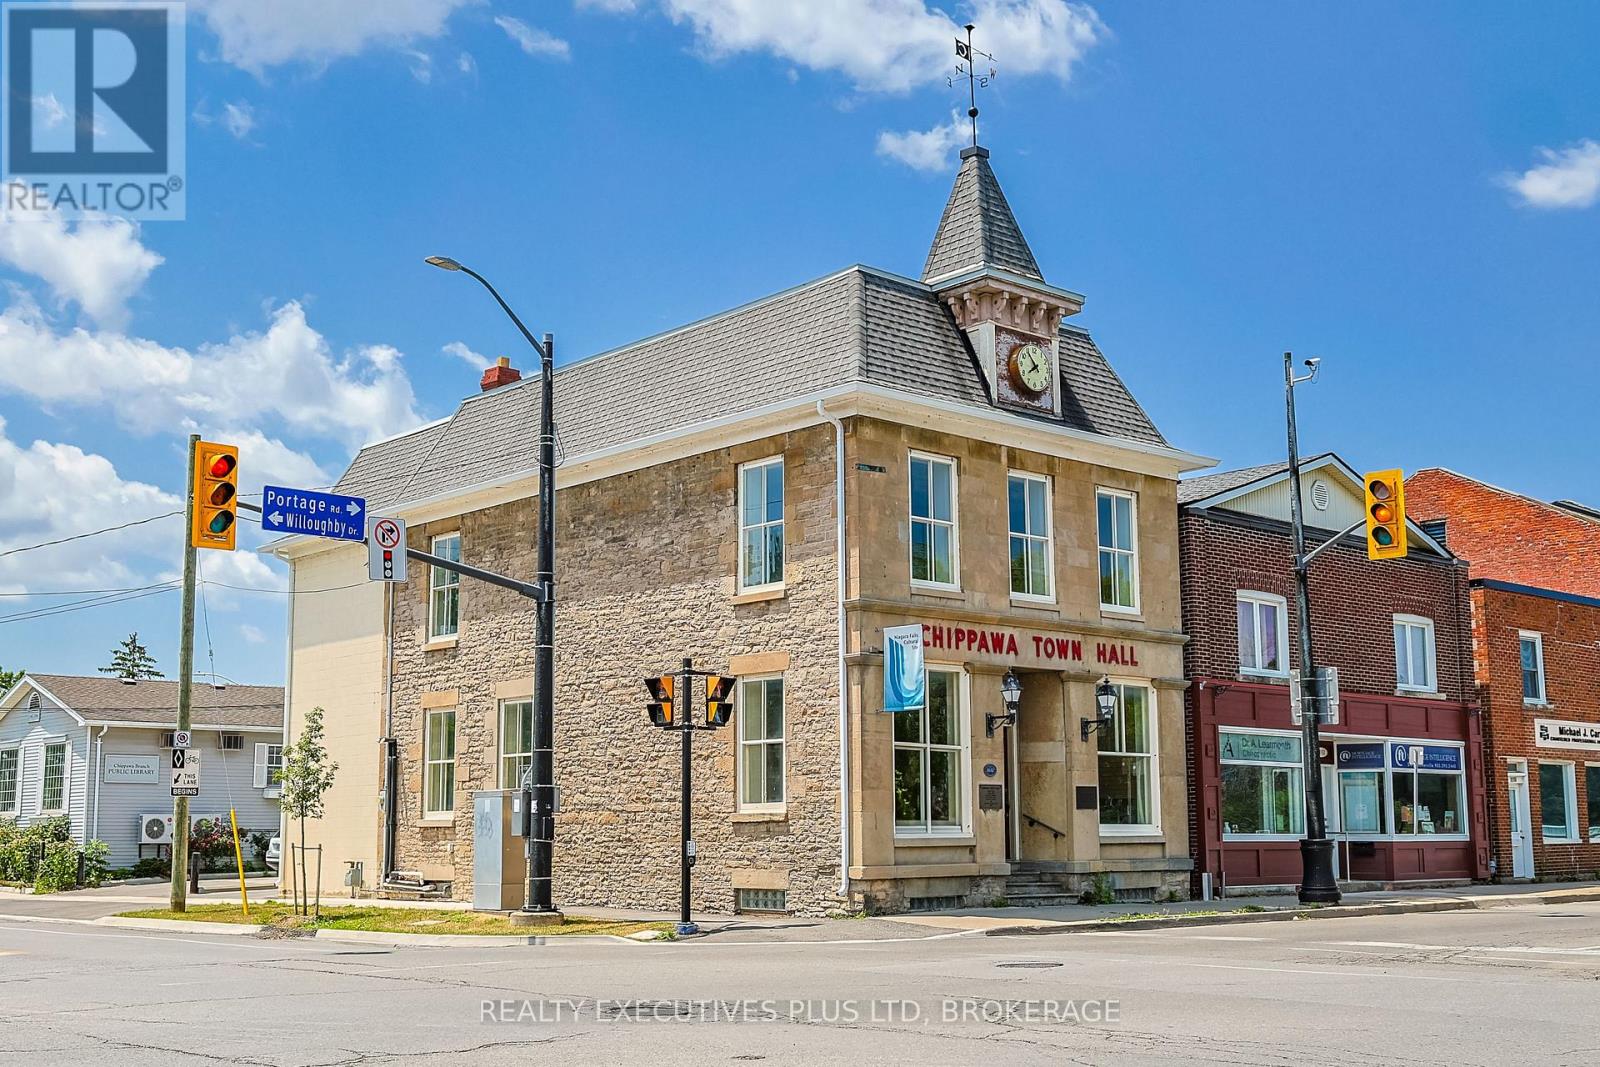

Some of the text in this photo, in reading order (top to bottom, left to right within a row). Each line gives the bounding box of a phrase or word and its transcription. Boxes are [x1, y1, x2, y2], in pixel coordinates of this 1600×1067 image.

[267, 490, 343, 514] Portage Rd.
[286, 512, 359, 537] Willoughby Dr.
[922, 624, 1139, 667] CHIPPAWA TOWN HALL
[1558, 726, 1582, 736] Michael
